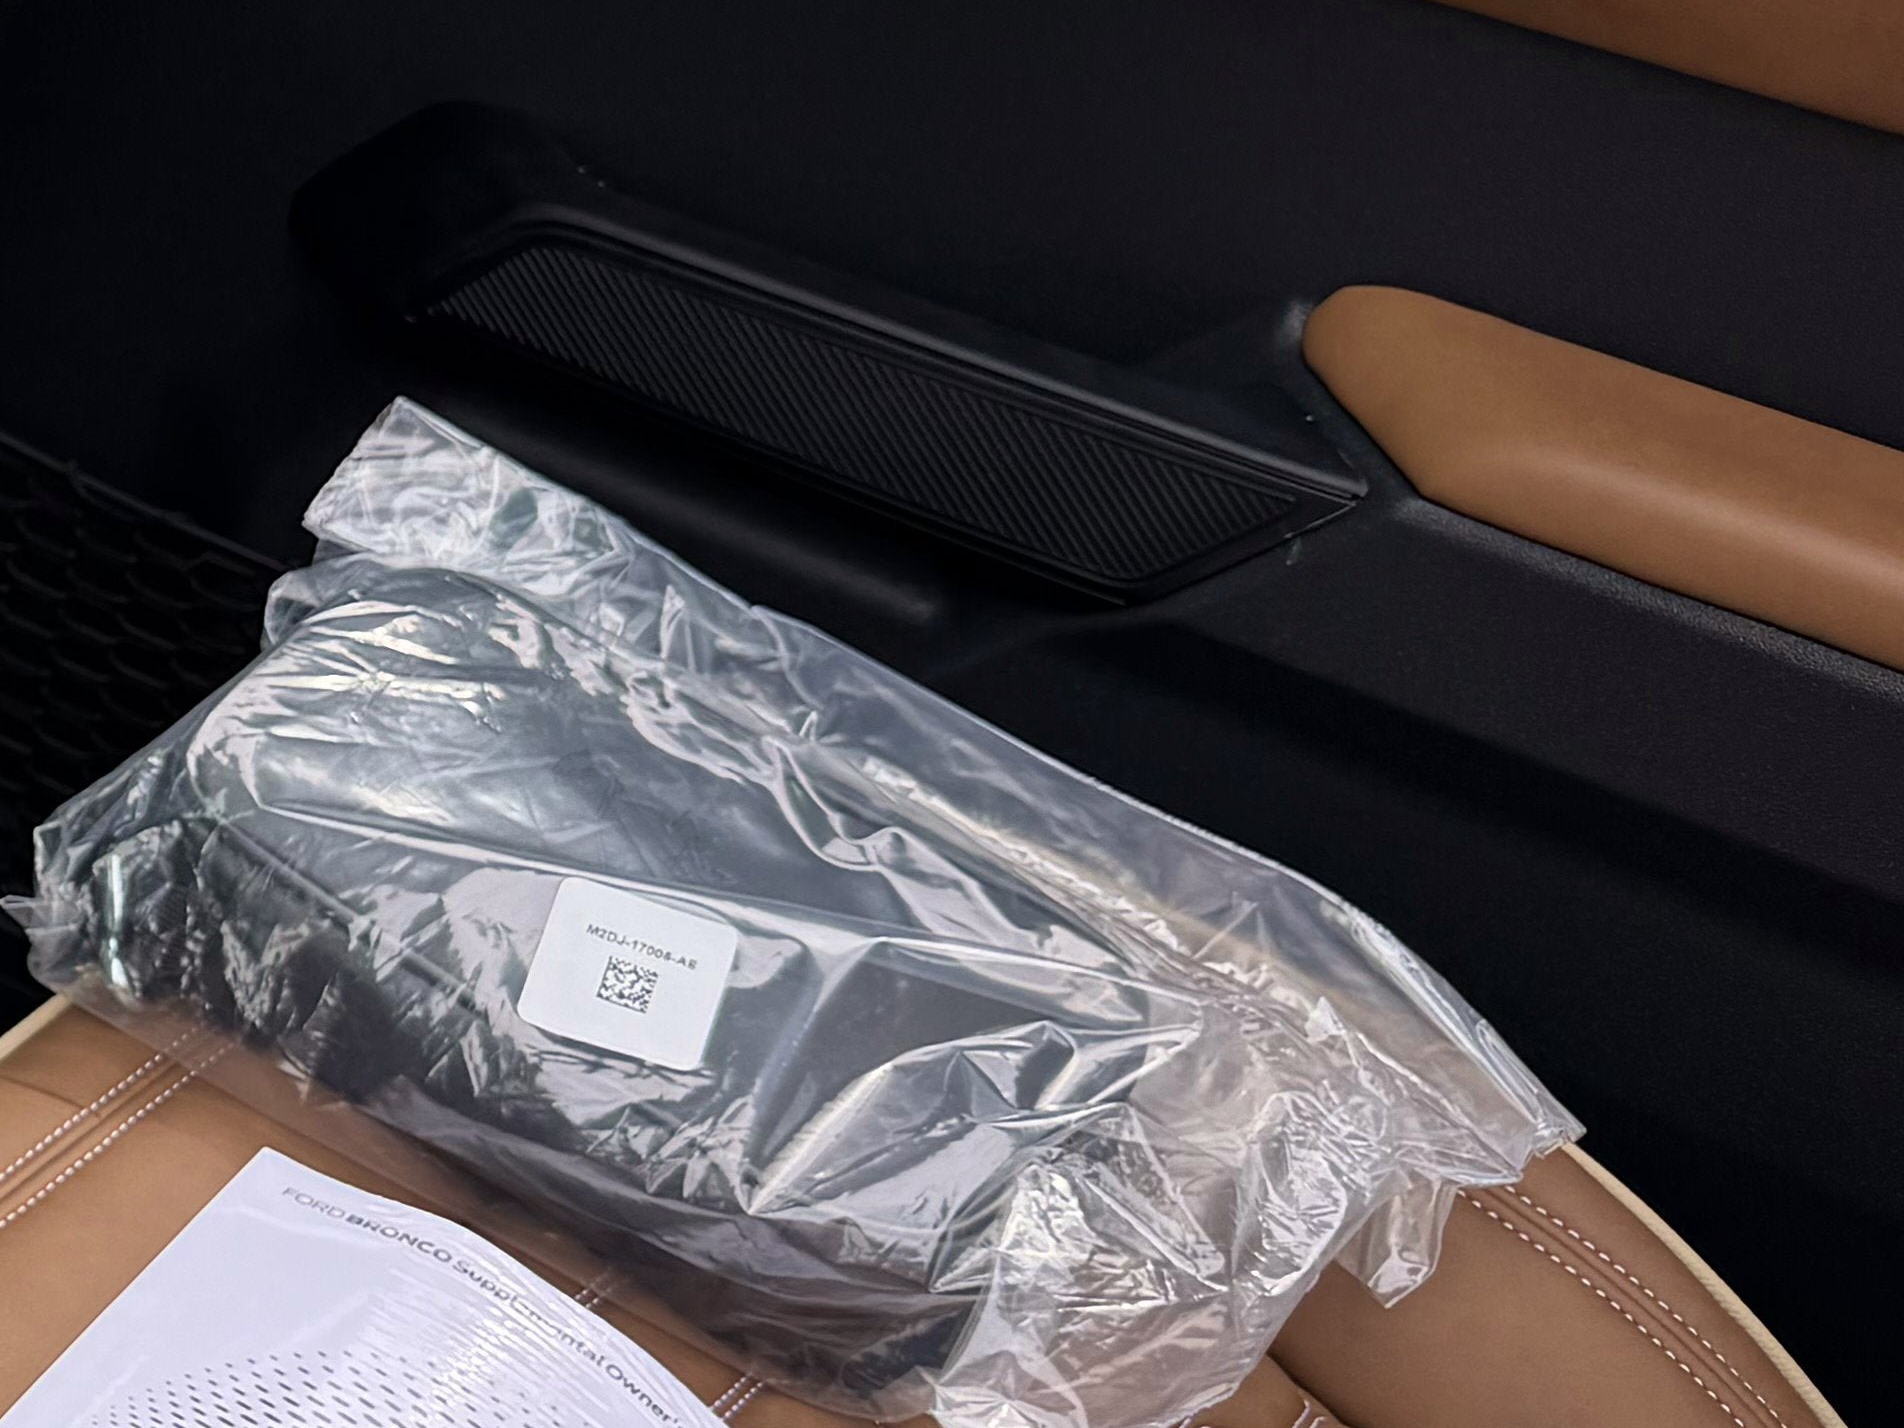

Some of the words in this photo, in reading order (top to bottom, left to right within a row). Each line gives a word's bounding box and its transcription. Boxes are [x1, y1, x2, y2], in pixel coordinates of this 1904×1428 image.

[281, 1186, 347, 1220] FORD
[345, 1214, 453, 1264] BRONCO
[452, 1258, 605, 1366] Supplntal
